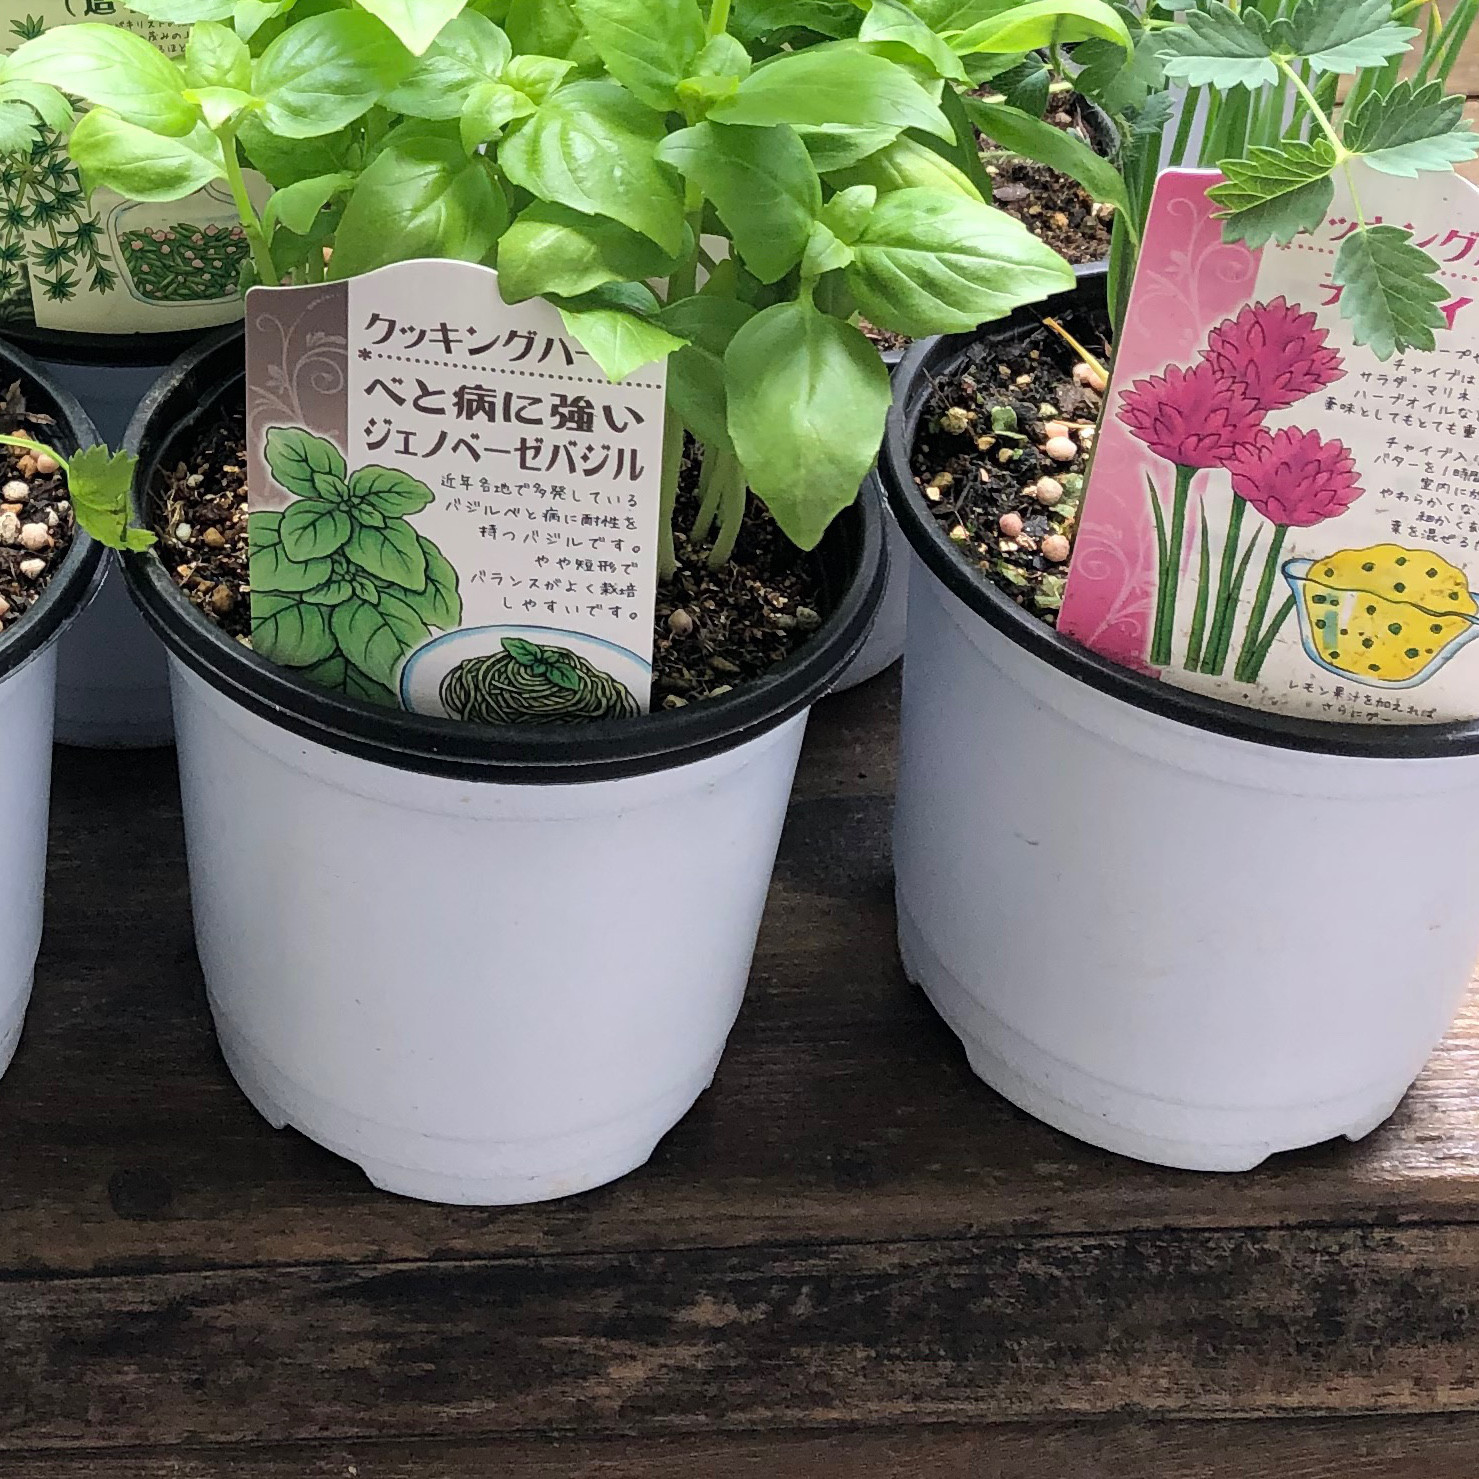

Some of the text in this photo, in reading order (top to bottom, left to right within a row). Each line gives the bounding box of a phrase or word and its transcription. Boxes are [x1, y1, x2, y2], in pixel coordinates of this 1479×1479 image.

[363, 376, 645, 434] べと病に強い
[363, 417, 644, 483] ジェノベーゼバジル
[440, 471, 638, 508] 近年各地で多発している
[470, 569, 638, 599] バランスがよく栽培
